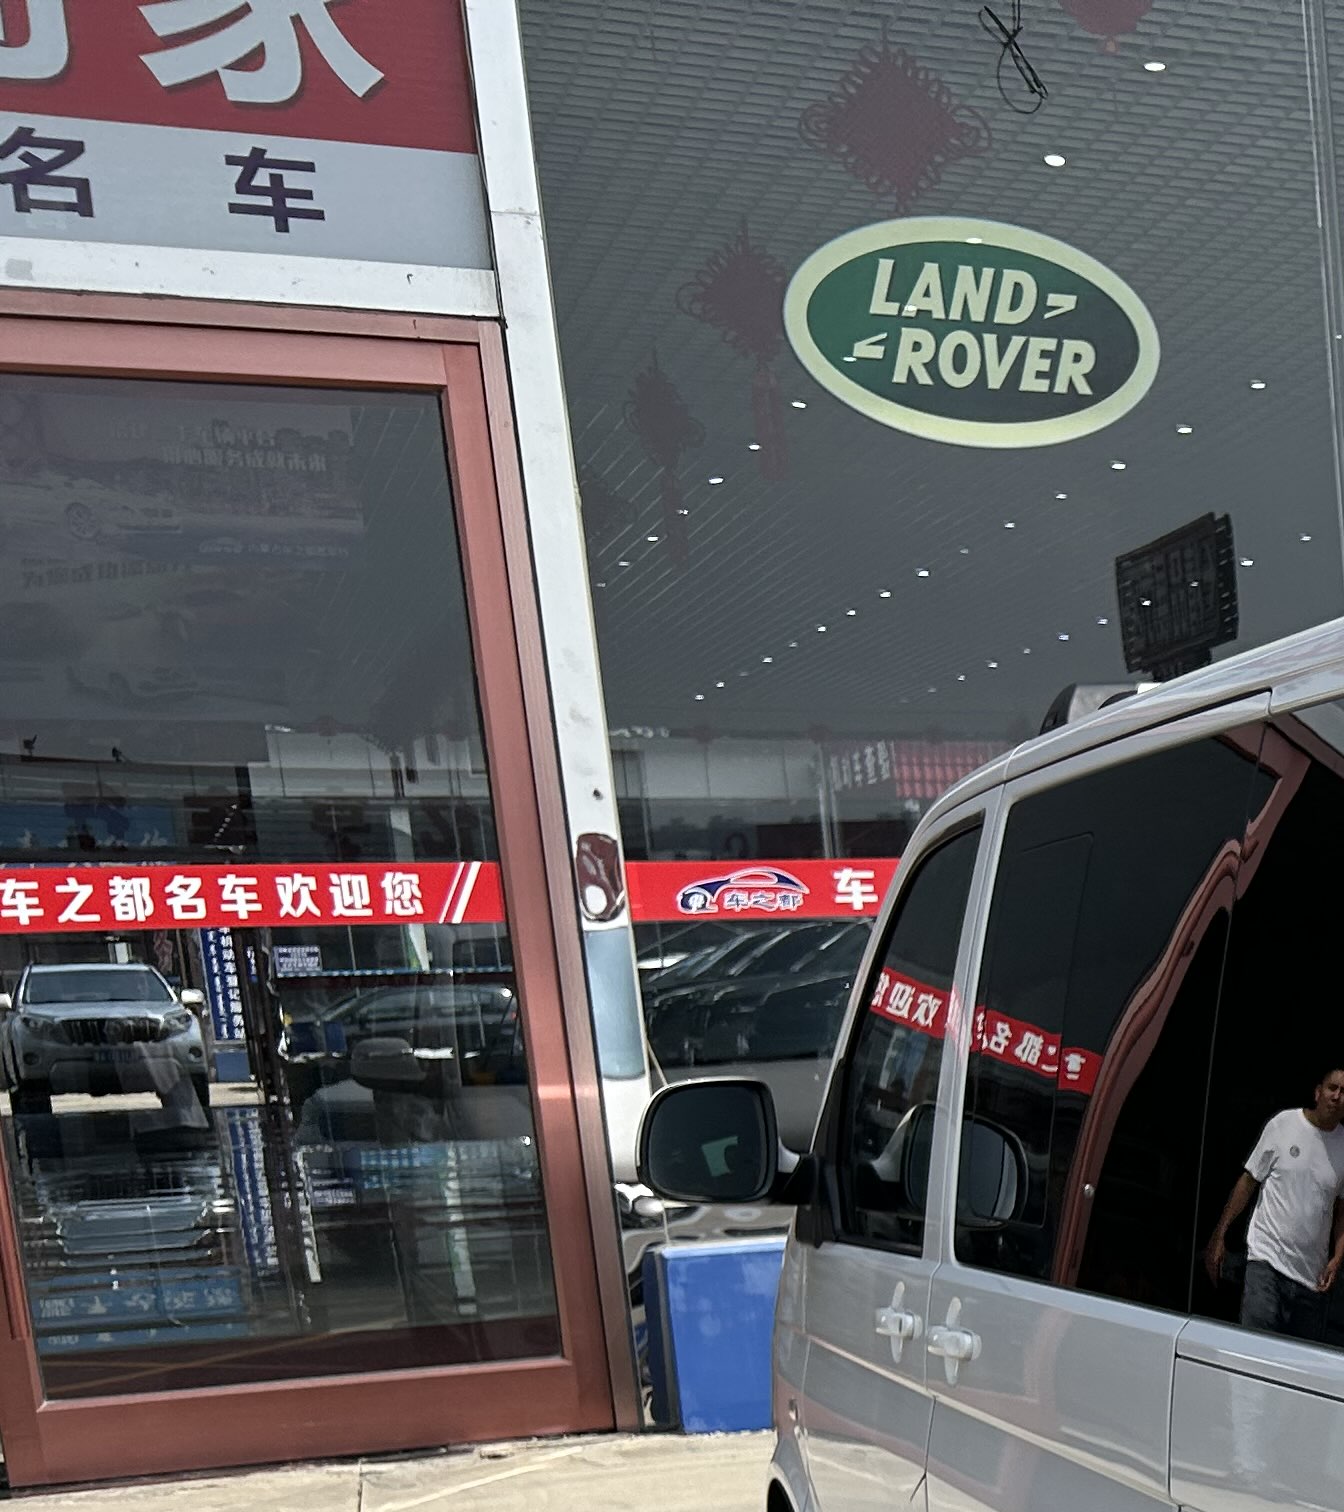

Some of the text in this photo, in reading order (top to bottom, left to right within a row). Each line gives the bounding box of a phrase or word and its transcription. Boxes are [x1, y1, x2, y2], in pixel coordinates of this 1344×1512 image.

[0, 126, 326, 234] 名车
[868, 257, 1038, 325] LAND
[892, 327, 1097, 396] ROVER
[0, 871, 425, 926] 车之都名车欢迎您
[724, 889, 804, 912] 车之都
[833, 867, 879, 912] 车
